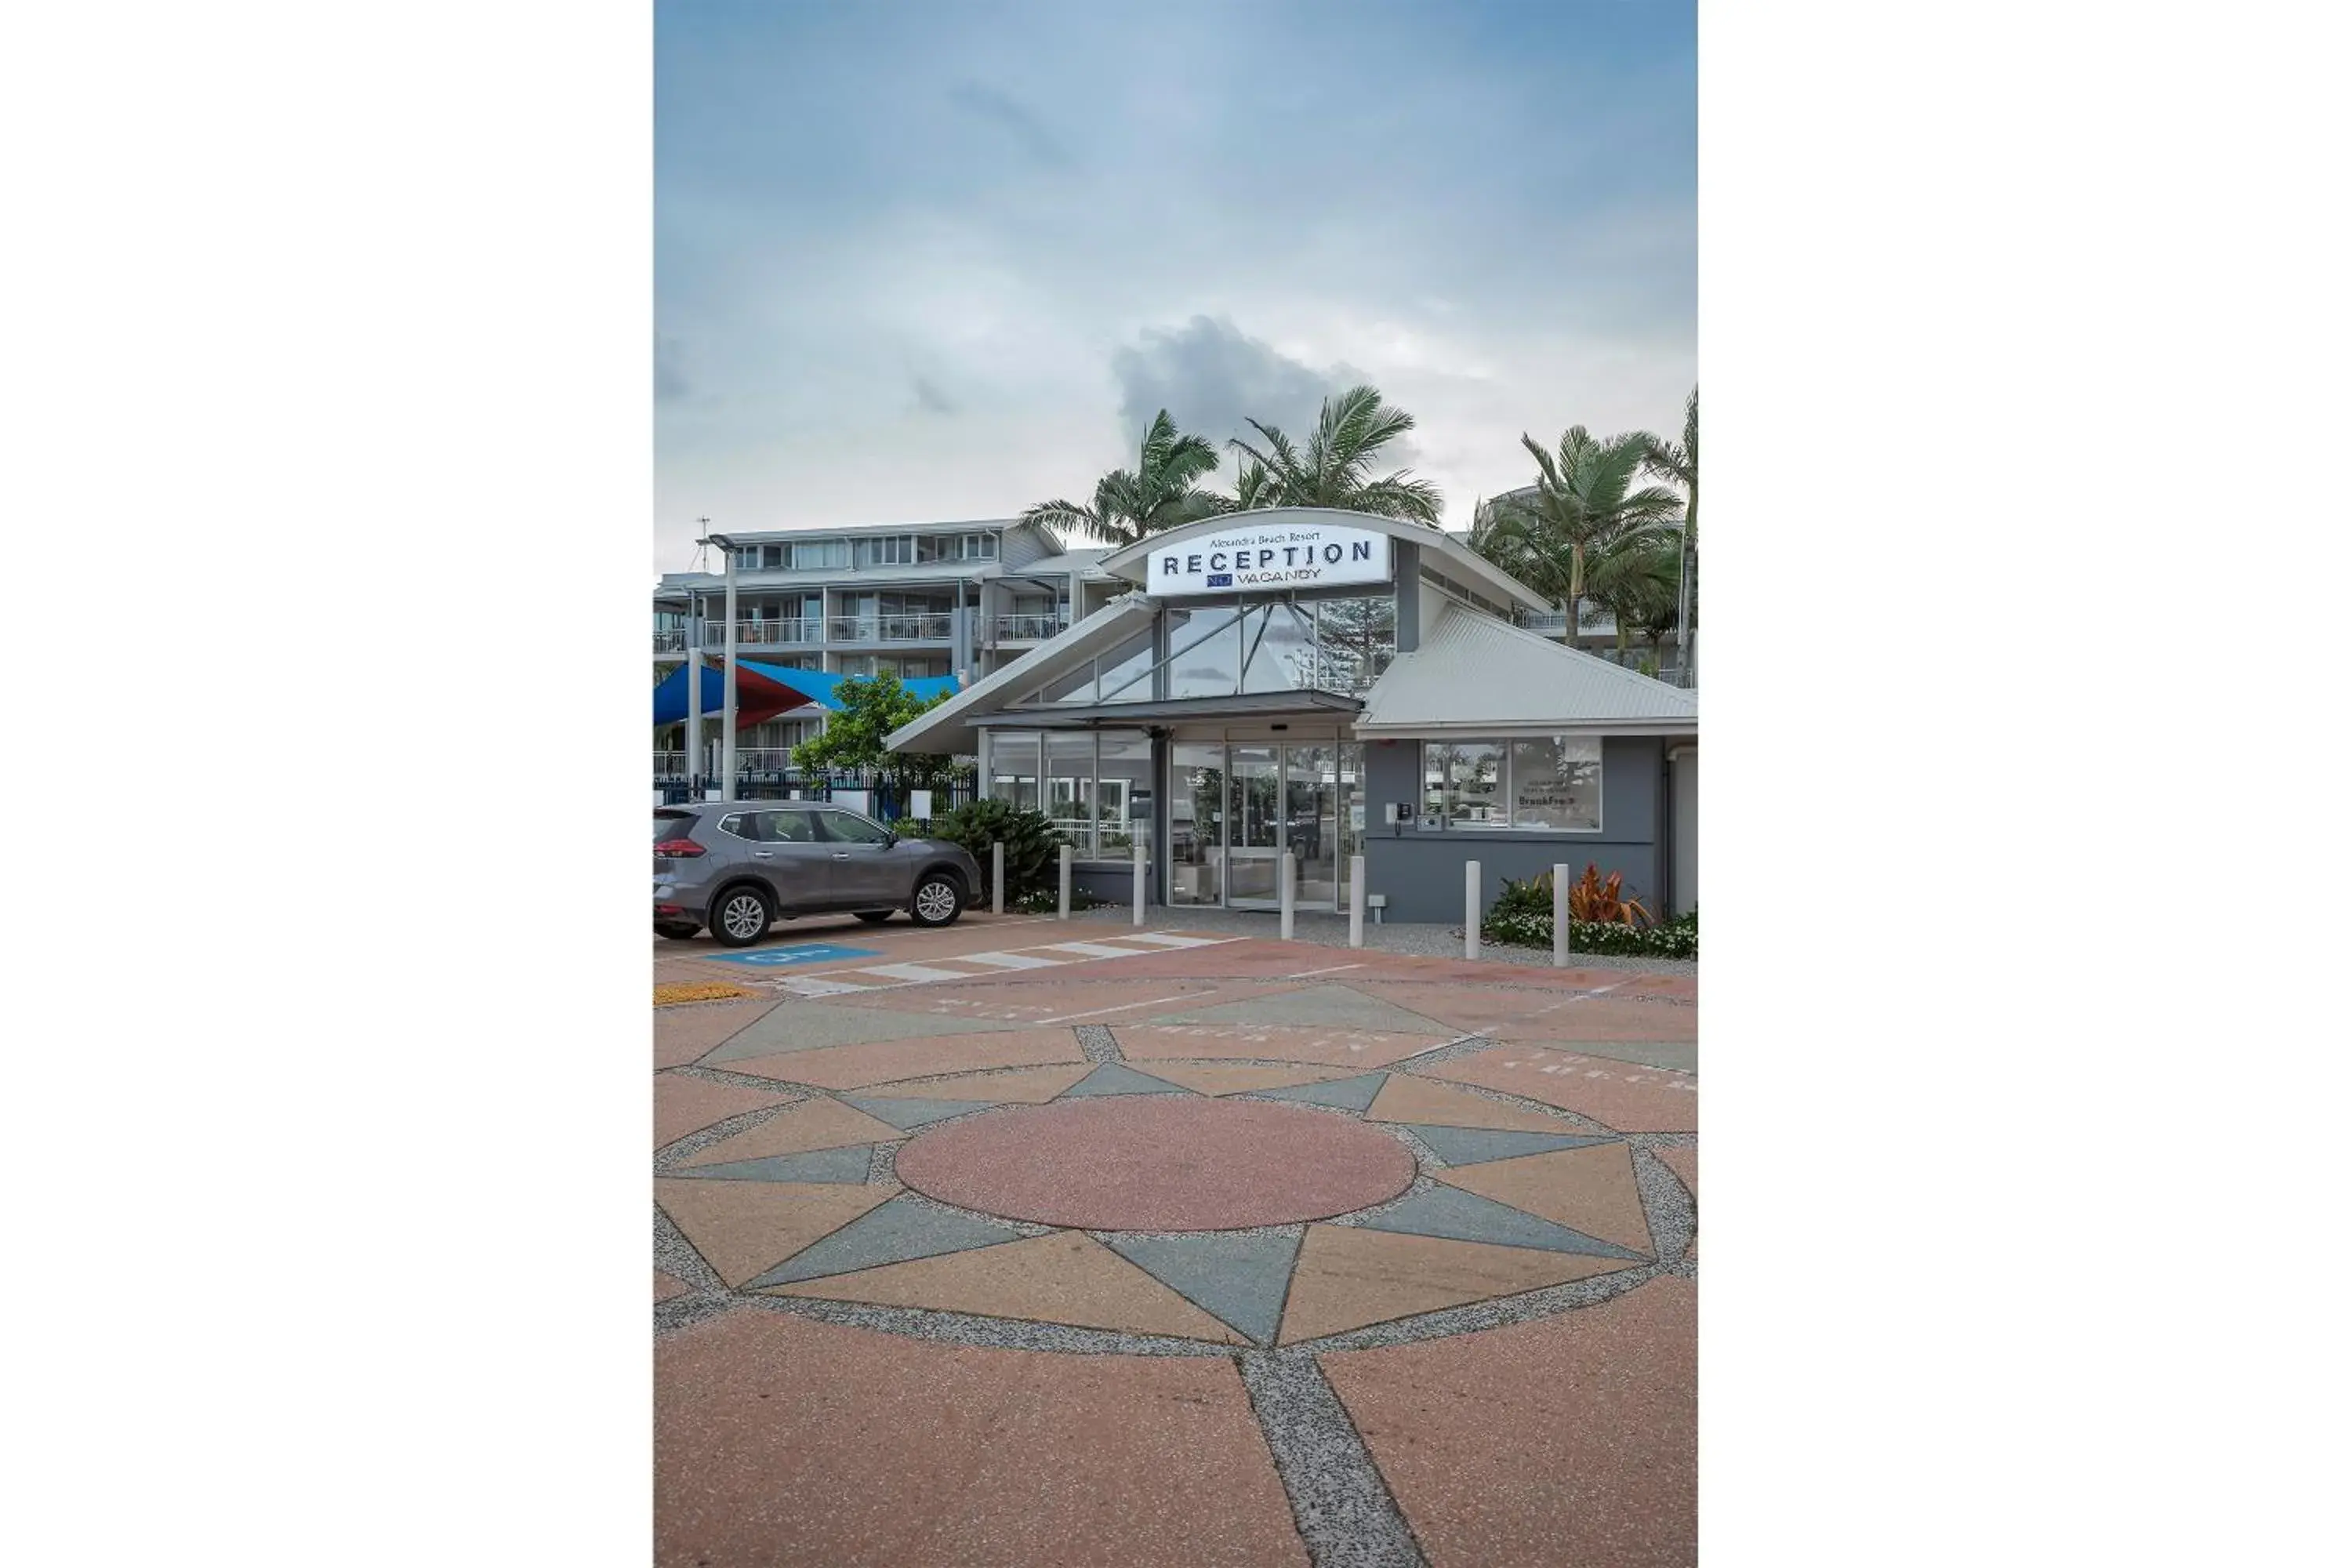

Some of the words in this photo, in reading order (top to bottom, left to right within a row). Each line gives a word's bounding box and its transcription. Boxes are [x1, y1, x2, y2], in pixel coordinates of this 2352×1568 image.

[1210, 537, 1255, 548] Alexandra
[1258, 534, 1285, 545] Beach
[1290, 532, 1320, 542] Resort
[1163, 541, 1371, 575] RECEPTION
[1207, 575, 1232, 586] NO
